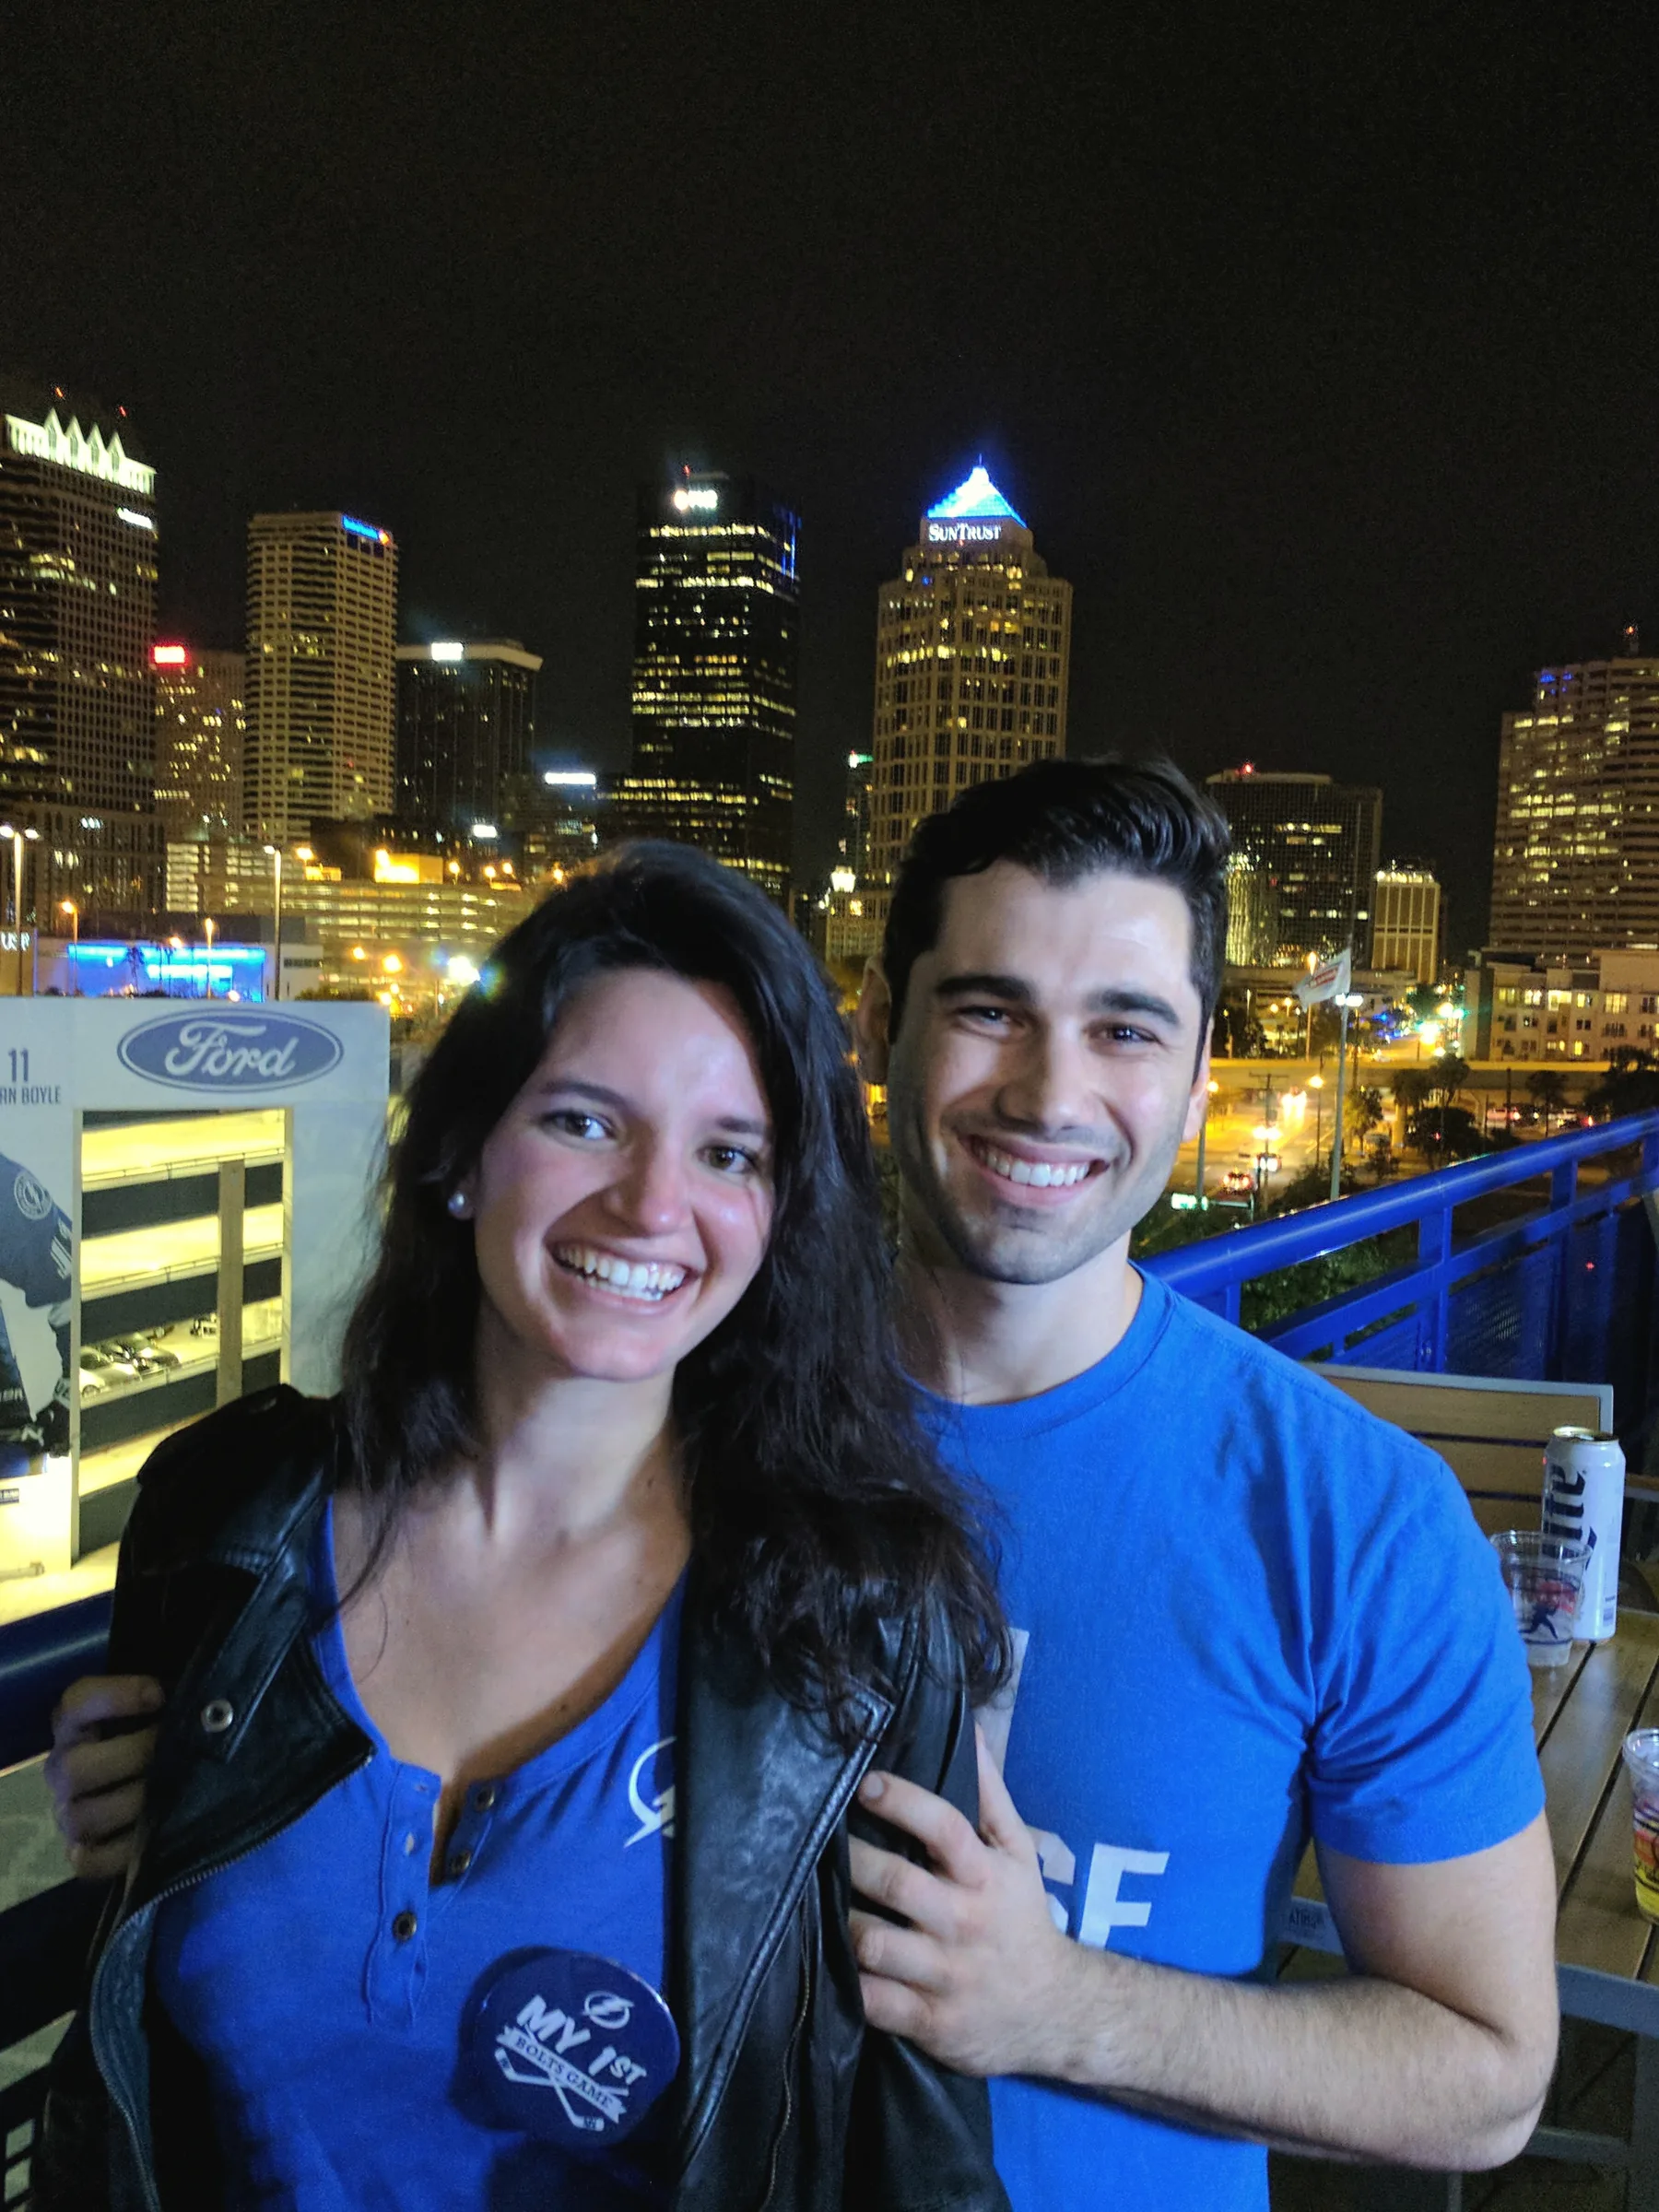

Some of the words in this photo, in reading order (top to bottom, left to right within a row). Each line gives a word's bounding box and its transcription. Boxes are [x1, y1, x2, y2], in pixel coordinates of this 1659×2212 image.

[8, 1047, 29, 1083] 11
[164, 1020, 300, 1077] Ford
[21, 1086, 62, 1105] BOYLE
[516, 1994, 592, 2055] MY
[588, 2044, 647, 2086] 1ST
[515, 2035, 565, 2075] BOLTS
[566, 2072, 615, 2110] GAME
